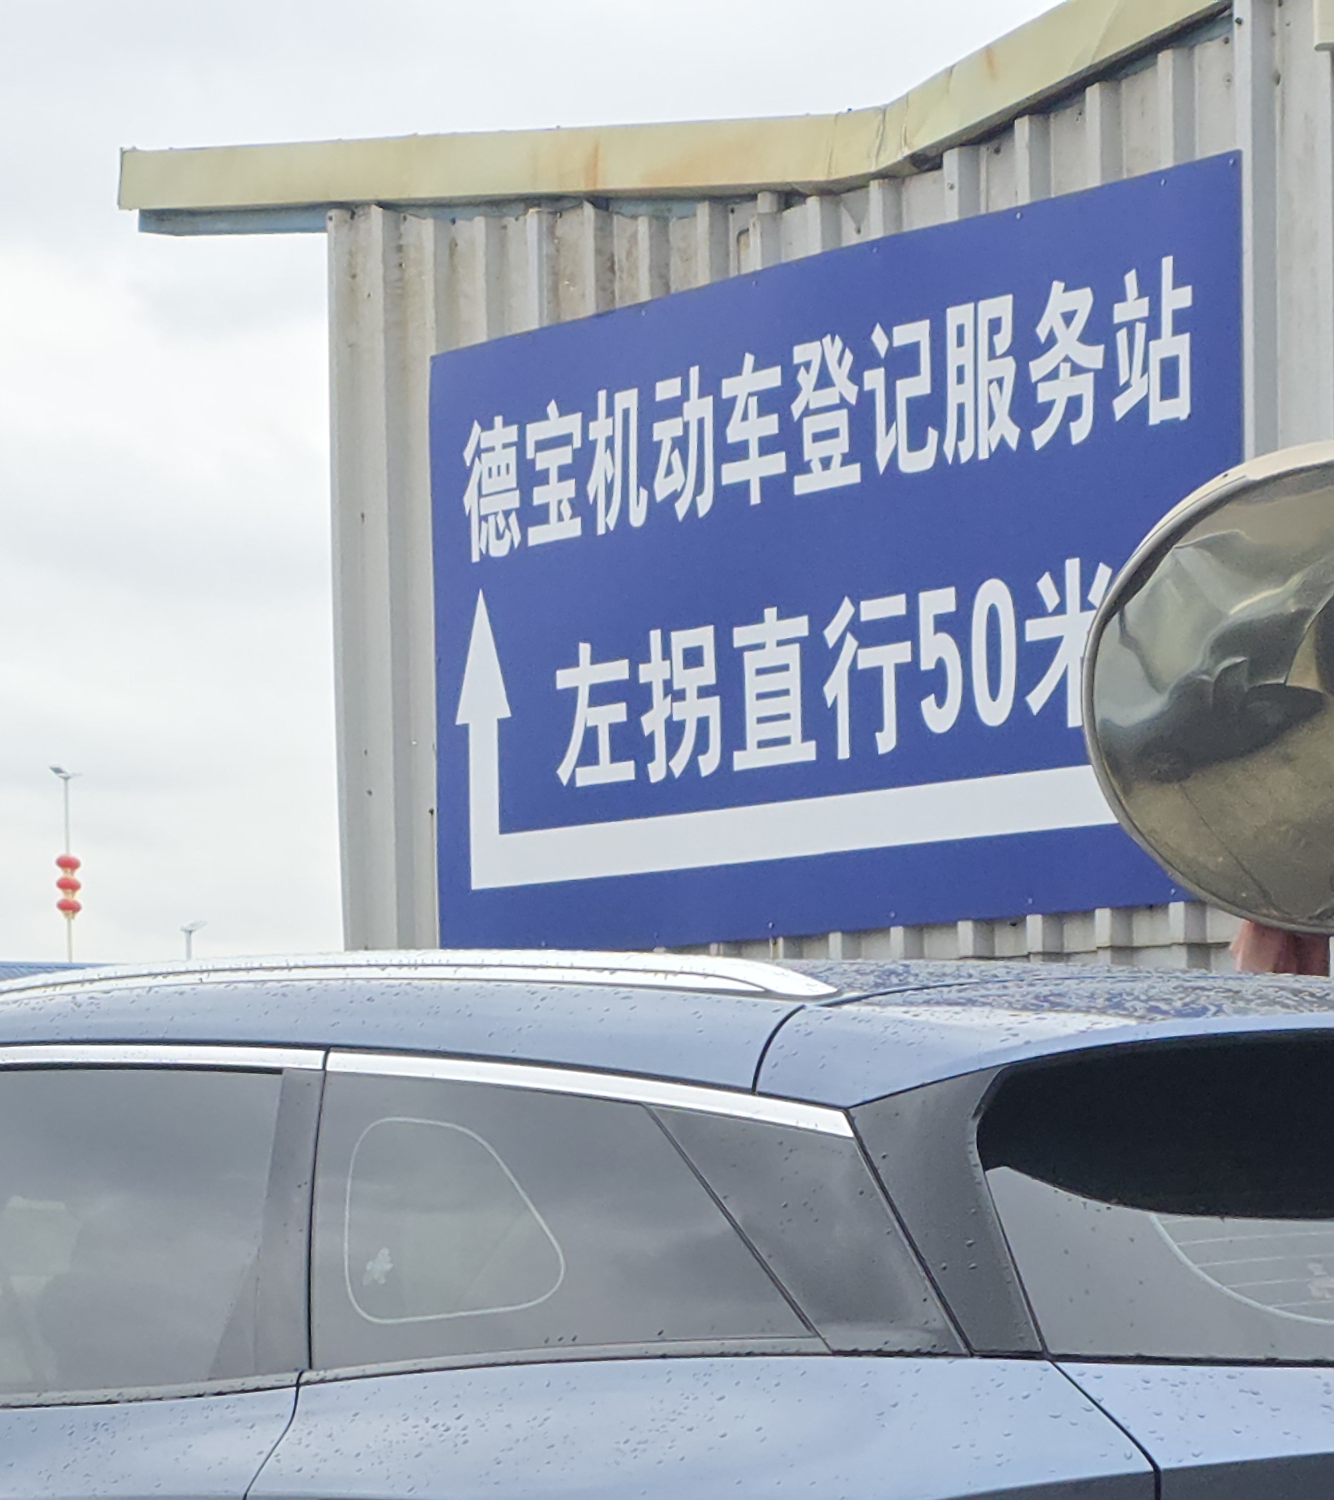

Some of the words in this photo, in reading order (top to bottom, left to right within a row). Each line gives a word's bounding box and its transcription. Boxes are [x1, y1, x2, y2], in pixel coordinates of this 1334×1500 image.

[462, 256, 1193, 562] 德宝机动车登记服务站
[556, 558, 1113, 788] 左拐直行50米
